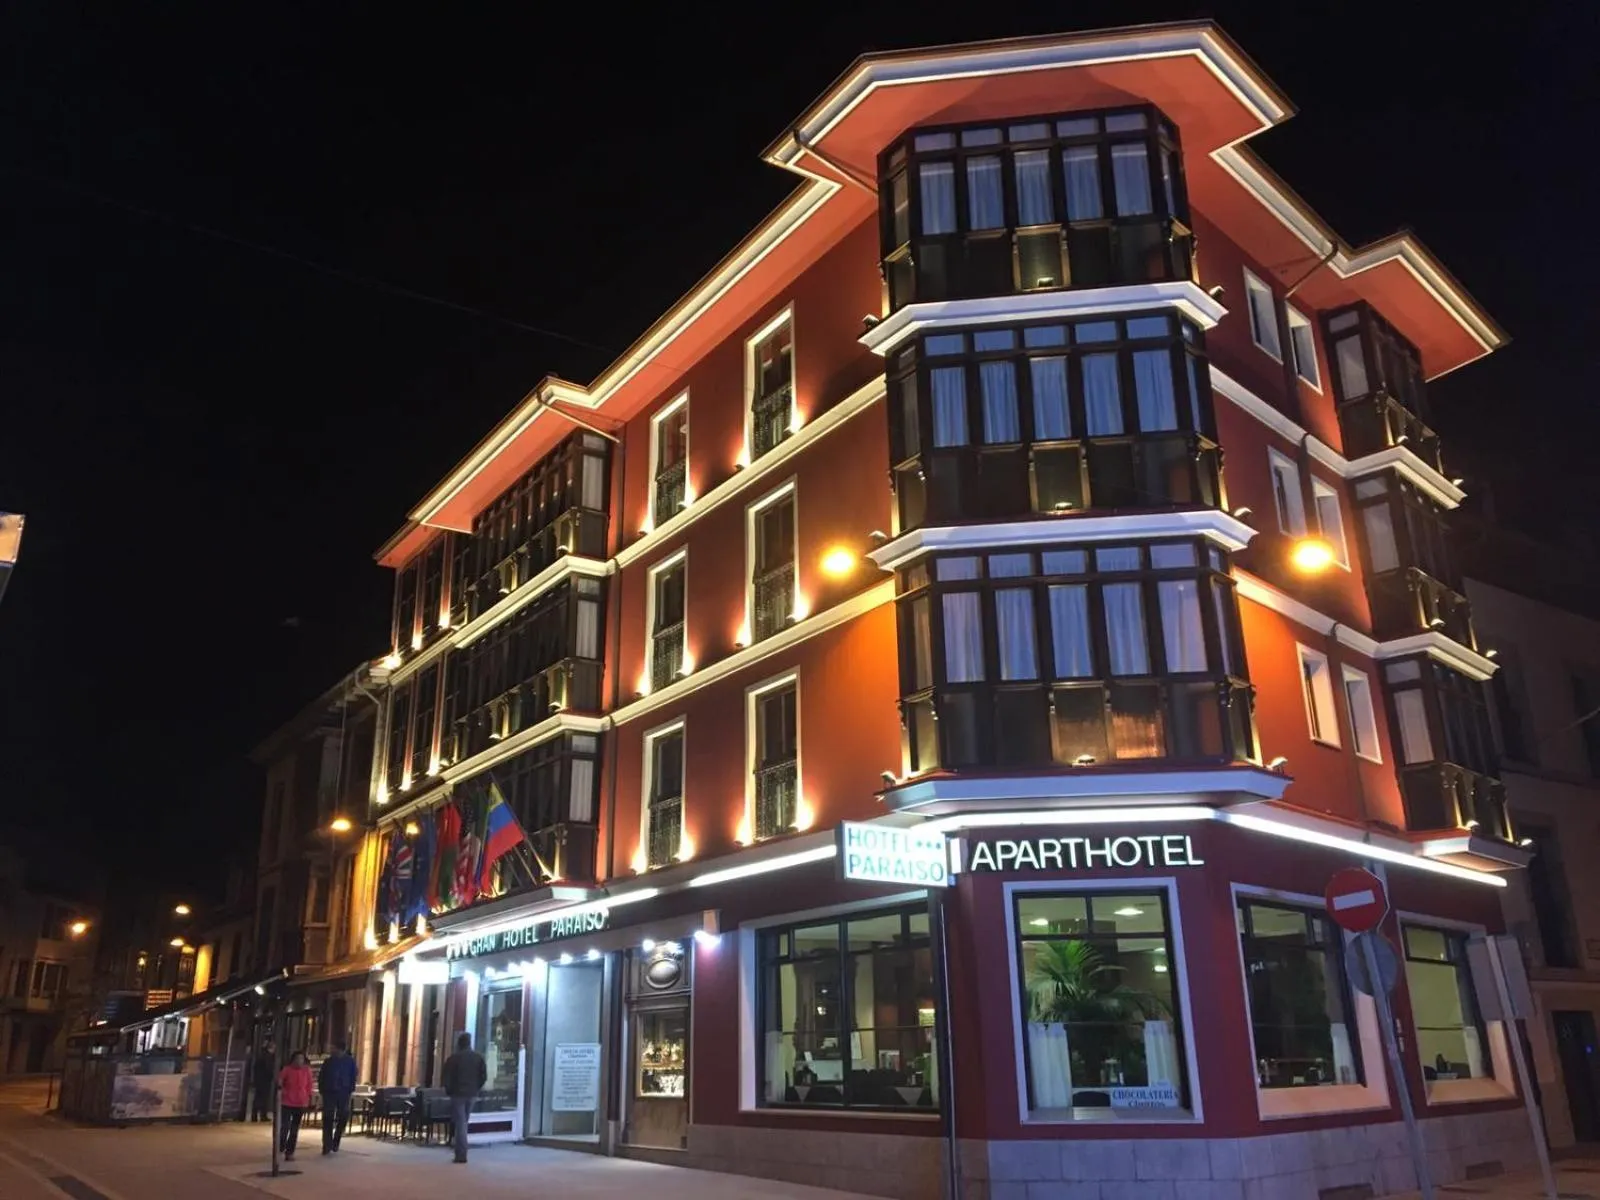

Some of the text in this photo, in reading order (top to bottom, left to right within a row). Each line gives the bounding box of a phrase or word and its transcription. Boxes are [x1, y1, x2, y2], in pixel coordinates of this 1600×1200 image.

[848, 828, 911, 853] HOTEL
[971, 835, 1206, 872] APARTHOTEL
[849, 854, 945, 882] PARAISO
[469, 909, 607, 956] GRAN HOTEL PARAISO
